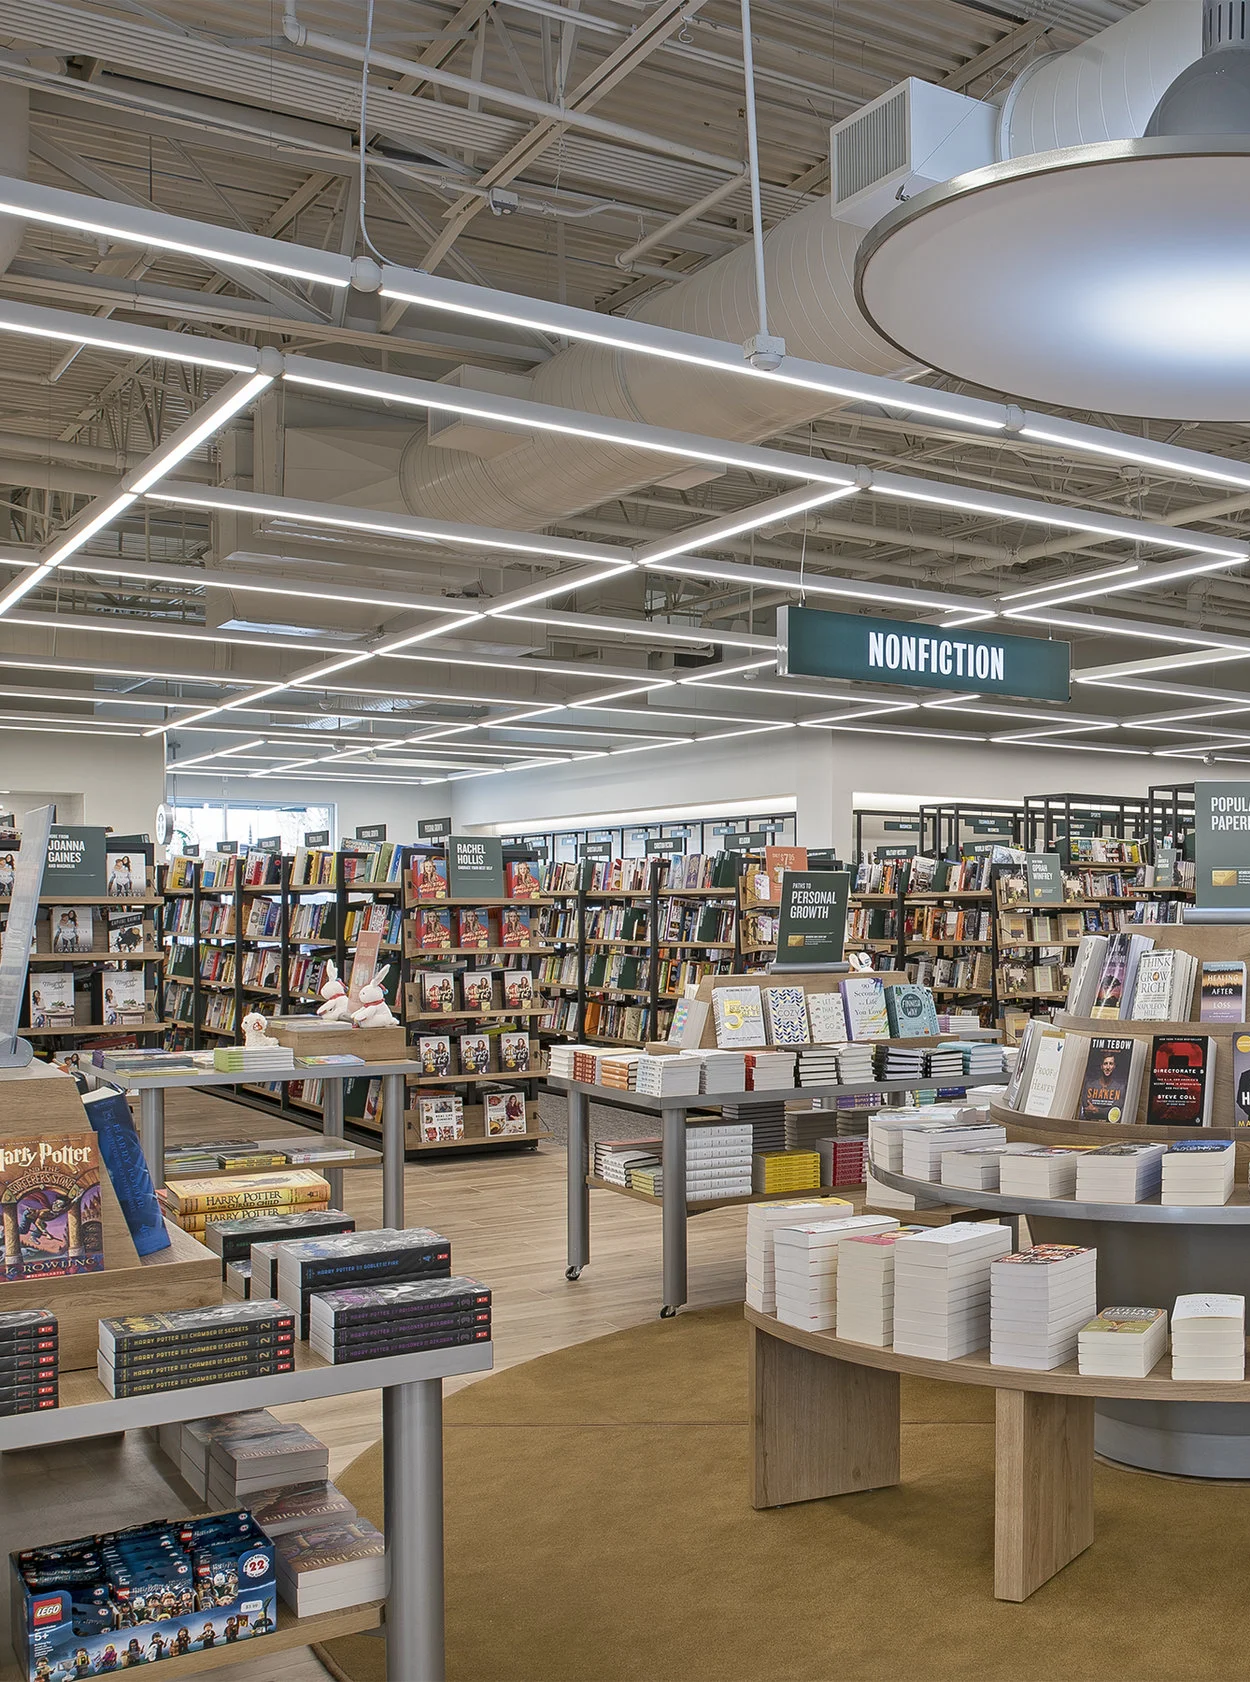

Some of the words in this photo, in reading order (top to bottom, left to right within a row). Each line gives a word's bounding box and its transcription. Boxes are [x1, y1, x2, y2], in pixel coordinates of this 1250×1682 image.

[868, 631, 1004, 681] NONFICTION
[48, 839, 85, 851] JOANNA
[457, 843, 486, 854] RACHEL
[48, 852, 82, 863] GAINES
[457, 854, 484, 865] HOLLIS
[1032, 864, 1048, 872] OPRAH
[1033, 873, 1053, 881] WINFREY
[791, 891, 837, 904] PERSONAL
[790, 905, 829, 919] GROWTH
[1141, 957, 1171, 968] THINK
[1140, 971, 1169, 982] GROW
[1207, 974, 1239, 982] HEALING
[1141, 982, 1166, 994] RICH
[1212, 987, 1234, 995] AFTER
[854, 990, 878, 998] Seconds
[723, 999, 744, 1030] 5
[777, 1009, 800, 1017] COZY
[855, 1008, 867, 1016] You
[907, 1007, 918, 1015] WAY
[1092, 1039, 1105, 1049] TIM
[1107, 1039, 1132, 1050] TEBOW
[1032, 1080, 1054, 1093] HEAVEN
[1087, 1088, 1120, 1100] SHAKEN
[39, 1142, 91, 1169] Potter
[23, 1167, 40, 1176] AND
[206, 1194, 241, 1206] HARRY
[243, 1190, 282, 1203] POTTER
[23, 1257, 95, 1273] ROWLING
[156, 1335, 179, 1343] POTTER
[189, 1329, 217, 1339] CHAMBER
[224, 1325, 249, 1334] SECRETS
[249, 1560, 265, 1572] 22
[35, 1604, 61, 1618] LEGO
[34, 1632, 49, 1641] 5+
